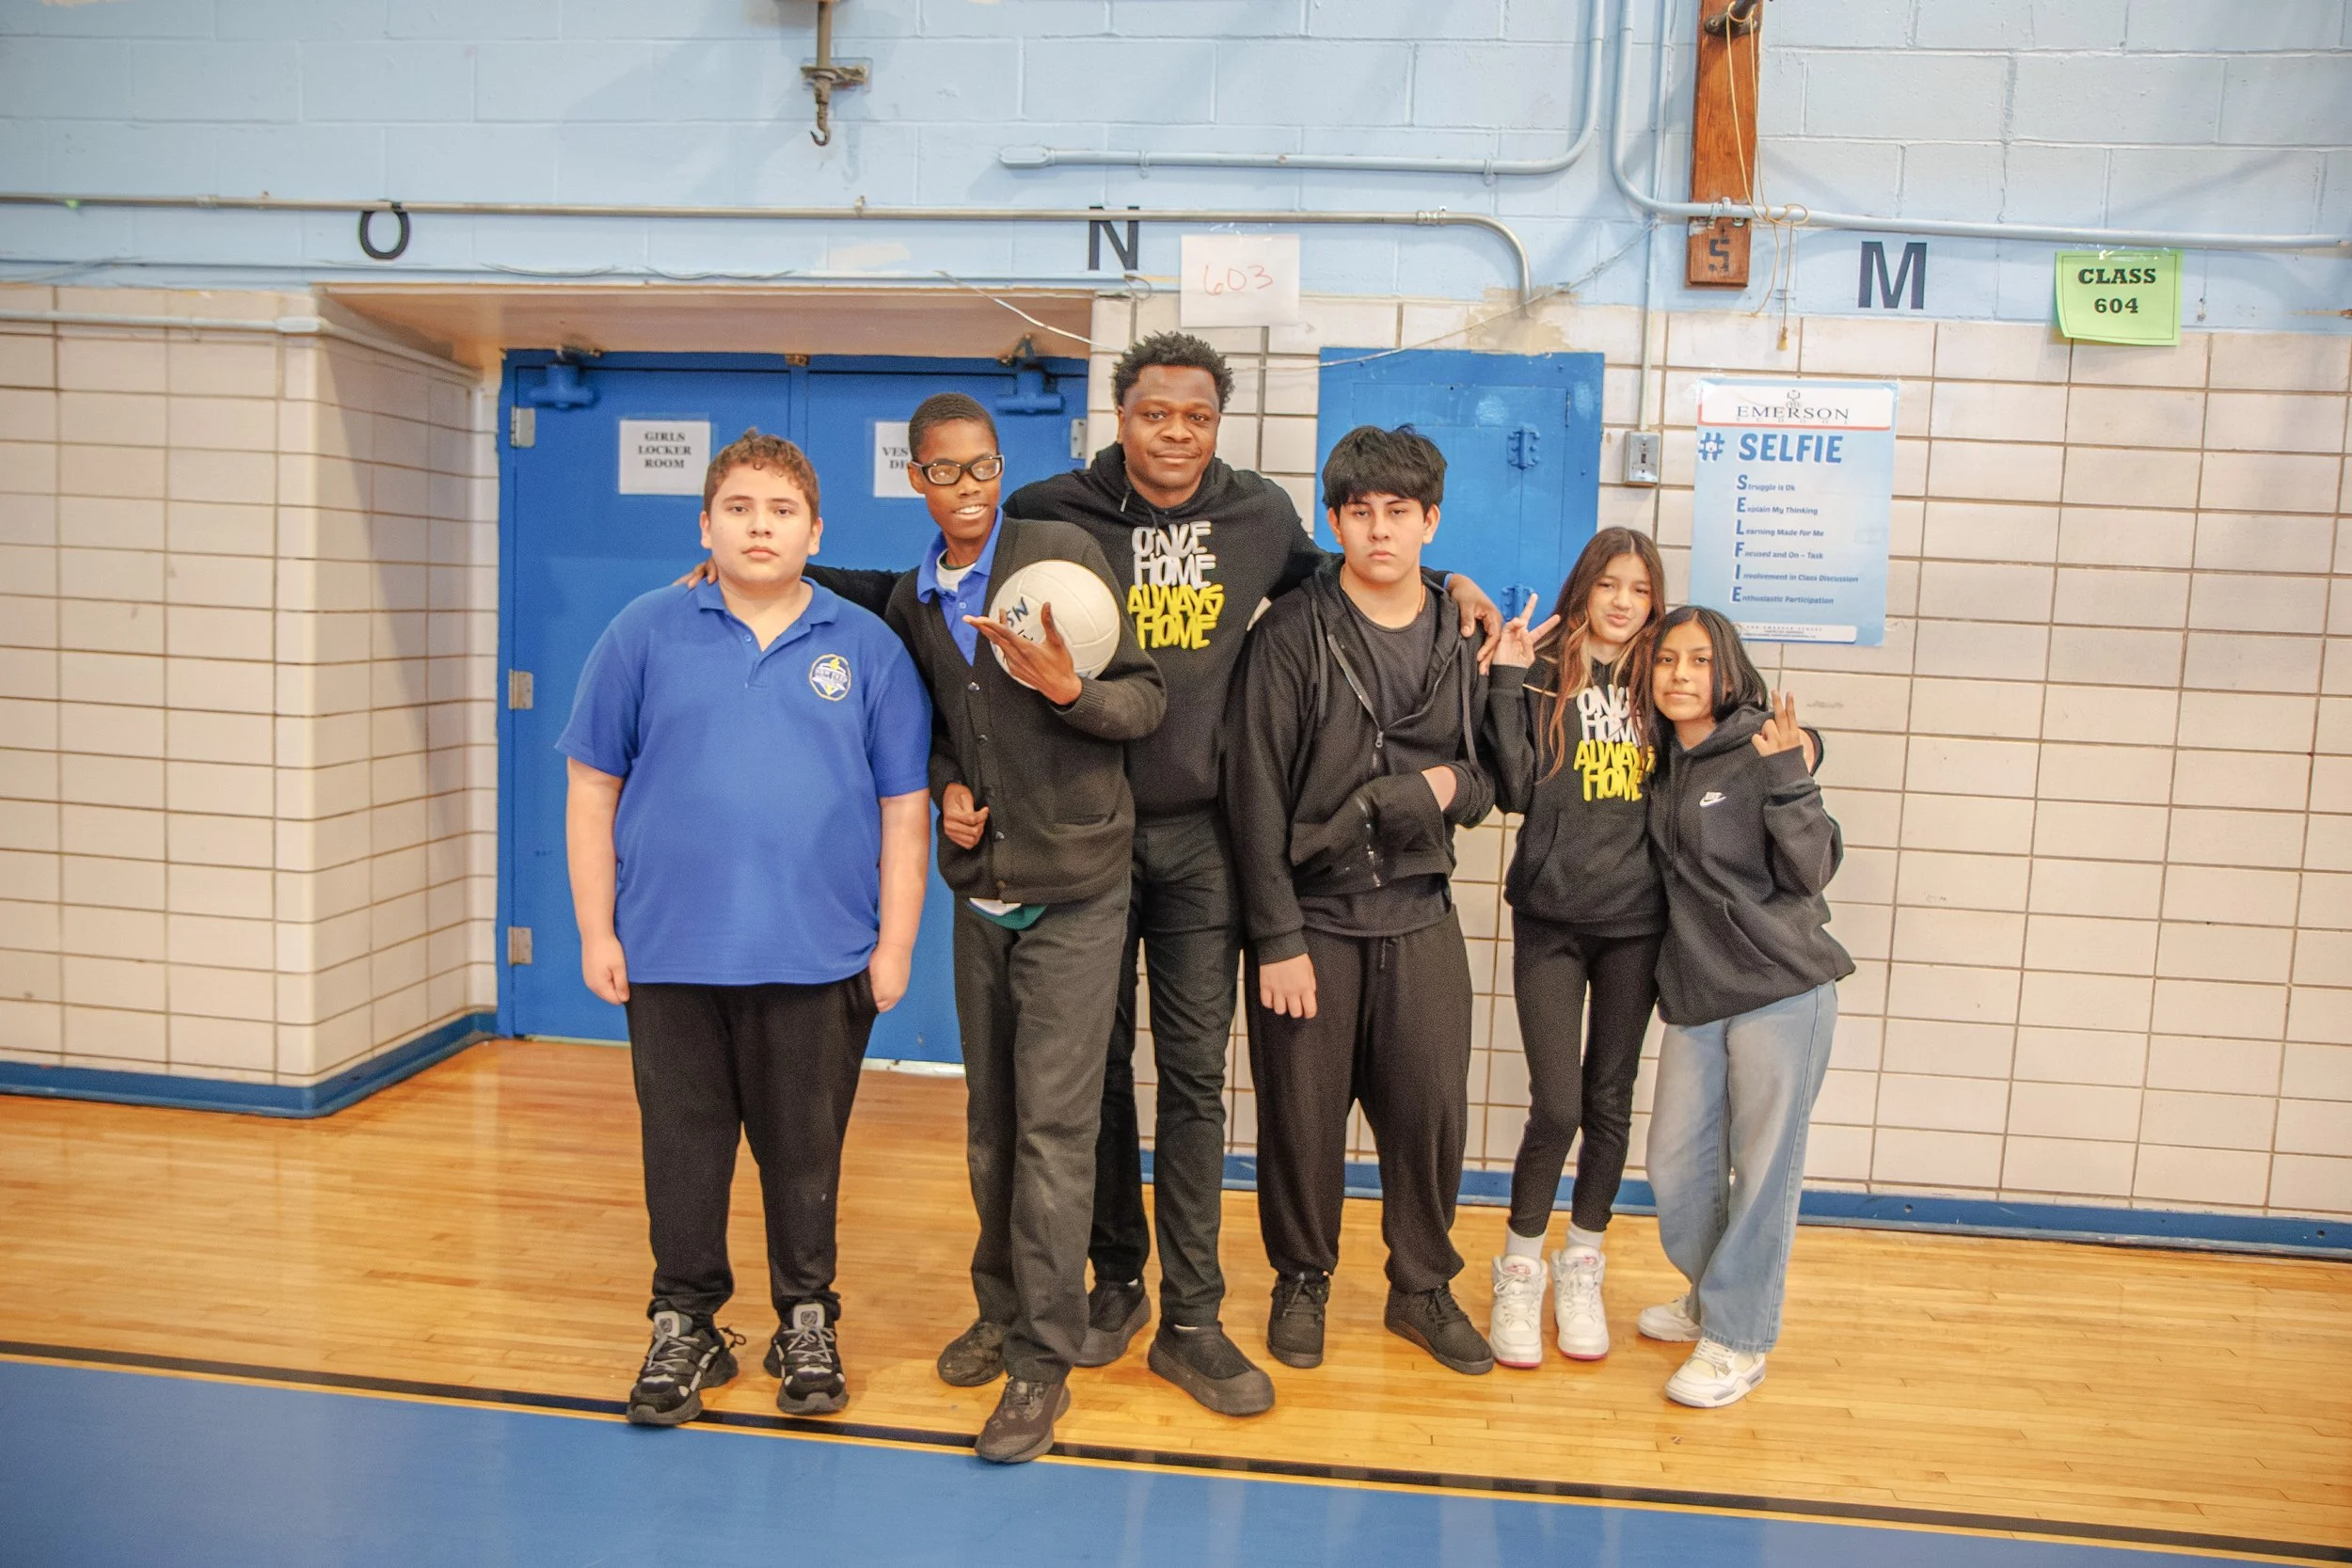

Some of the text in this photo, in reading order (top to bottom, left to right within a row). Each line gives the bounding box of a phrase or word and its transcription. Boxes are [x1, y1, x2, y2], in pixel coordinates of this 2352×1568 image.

[1089, 206, 1140, 270] N
[1203, 264, 1273, 296] 603
[1857, 240, 1928, 310] M
[2077, 266, 2157, 286] CLASS
[2093, 296, 2139, 315] 604
[1737, 405, 1849, 420] EMERSON
[644, 432, 686, 442] GIRLS
[638, 445, 691, 455] LOCKER
[1739, 433, 1844, 463] SELFIE
[644, 458, 685, 468] ROOM
[1772, 506, 1785, 515] My
[1786, 506, 1819, 515] Thinking
[1134, 552, 1216, 591] HOME
[1819, 575, 1858, 583] Discussion
[1127, 583, 1225, 618] ALWAYS
[1785, 595, 1834, 605] Participation
[1136, 612, 1216, 650] HOME
